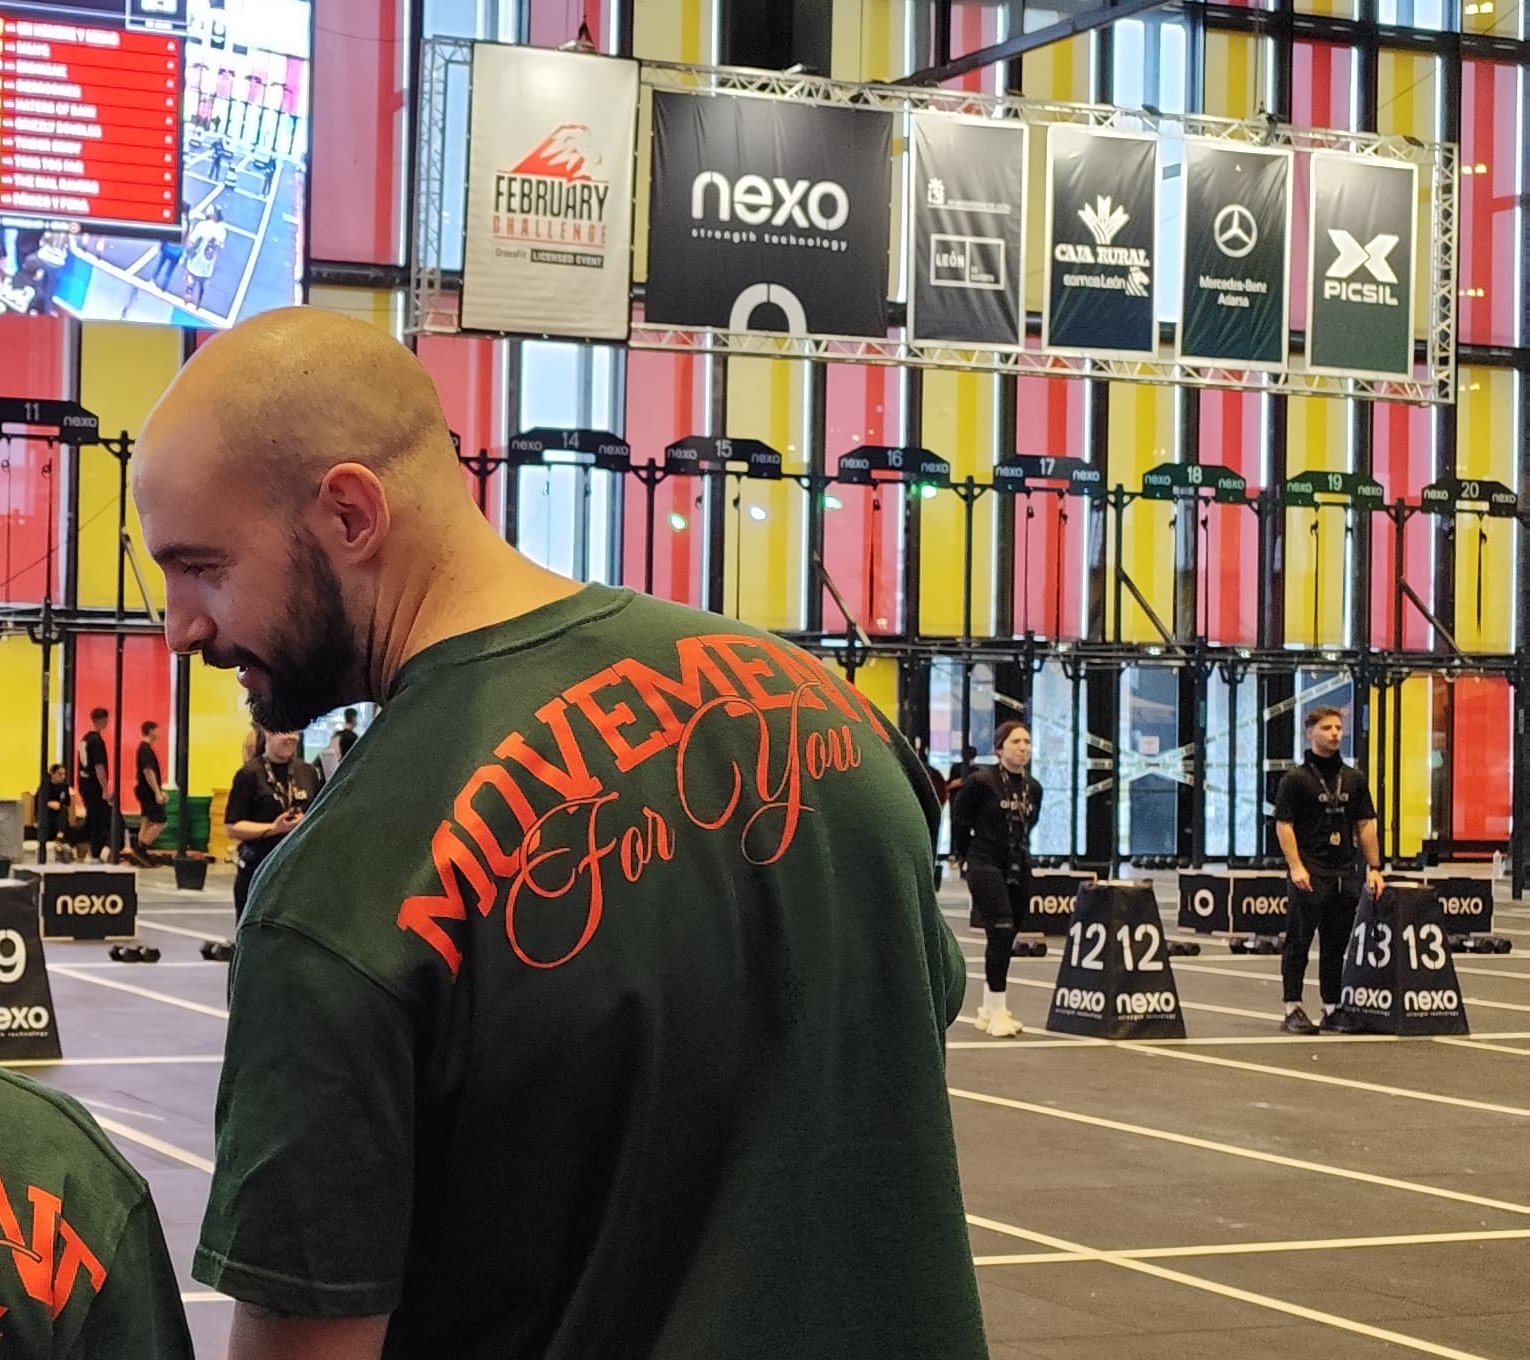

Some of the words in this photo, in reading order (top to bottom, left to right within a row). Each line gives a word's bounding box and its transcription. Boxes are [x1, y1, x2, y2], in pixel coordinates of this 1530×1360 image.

[495, 175, 609, 222] FEBRUARY
[691, 170, 849, 231] nexo
[493, 215, 607, 244] CHALLENGE
[691, 228, 757, 243] strength
[764, 233, 848, 251] technology
[576, 255, 602, 267] EVENT
[1055, 243, 1095, 263] CAJA
[1095, 246, 1150, 267] RURAL
[1324, 279, 1399, 306] PICSIL
[24, 402, 40, 421] 11
[63, 413, 97, 428] nexo
[512, 438, 543, 452] nexo
[561, 431, 580, 449] 14
[598, 442, 629, 456] nexo
[668, 446, 697, 460] nexo
[716, 440, 732, 458] 15
[751, 451, 781, 465] nexo
[841, 456, 869, 470] nexo
[887, 450, 903, 467] 16
[921, 461, 950, 474] nexo
[995, 465, 1024, 478] nexo
[1040, 458, 1055, 475] 17
[1072, 468, 1100, 482] nexo
[1144, 473, 1171, 486] nexo
[1187, 467, 1202, 483] 18
[1218, 477, 1244, 490] nexo
[1287, 480, 1312, 493] nexo
[1328, 474, 1342, 491] 19
[1357, 484, 1383, 497] nexo
[1423, 486, 1448, 500] nexo
[1461, 482, 1479, 498] 20
[1491, 490, 1517, 504] nexo
[505, 792, 675, 969] For
[677, 680, 861, 866] You
[55, 893, 124, 916] nexo
[1069, 921, 1107, 971] 12
[1116, 923, 1164, 972] 12
[1354, 921, 1392, 969] 13
[1402, 923, 1447, 971] 13
[1055, 987, 1105, 1012] nexo
[1116, 991, 1176, 1014] nexo
[1340, 985, 1393, 1009] nexo
[1404, 990, 1458, 1011] nexo
